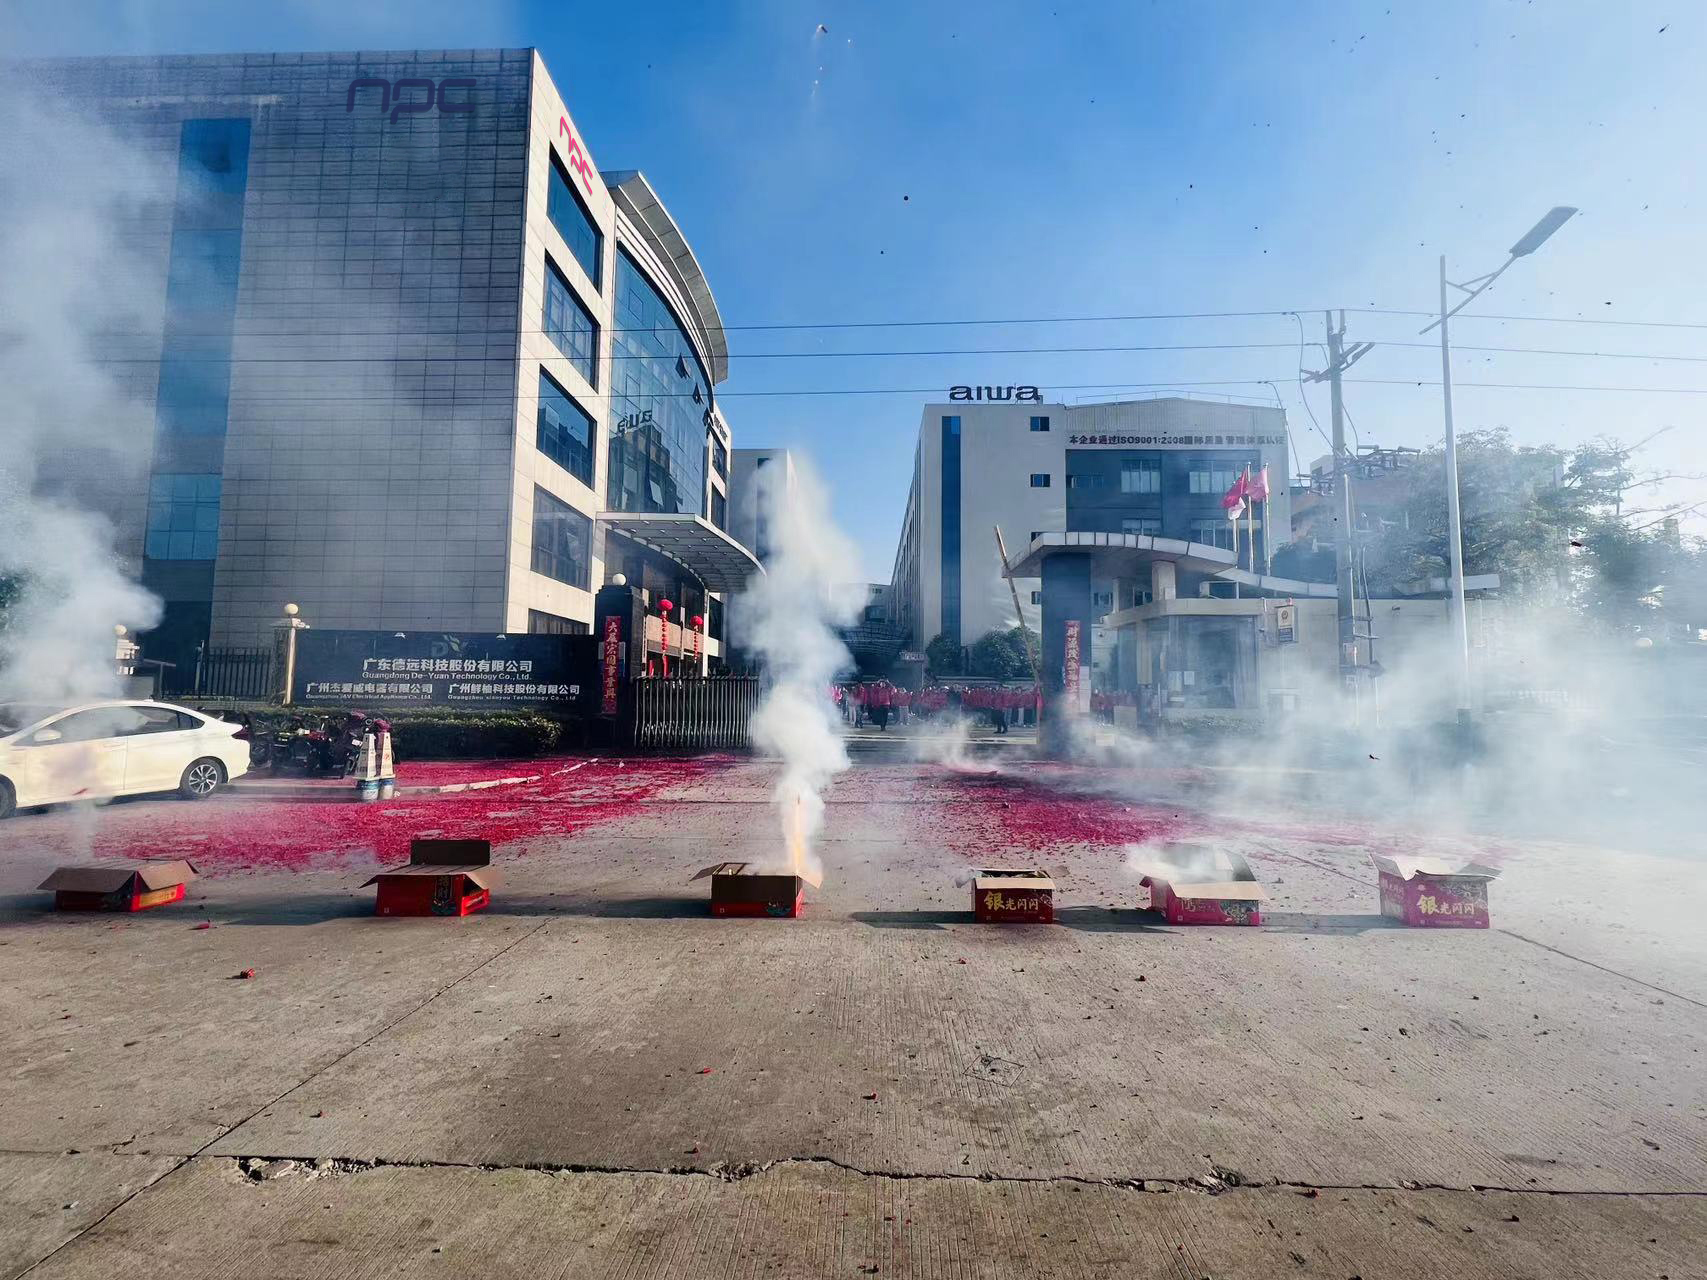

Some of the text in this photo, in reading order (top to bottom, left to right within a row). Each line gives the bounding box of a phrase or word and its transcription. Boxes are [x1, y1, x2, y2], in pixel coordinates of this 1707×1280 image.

[346, 79, 477, 125] npc
[560, 116, 594, 196] npc
[949, 386, 1041, 401] aiwa
[363, 658, 532, 673] 广东德远科技股份有限公司
[362, 671, 410, 681] Guangdong
[450, 672, 497, 681] Technology
